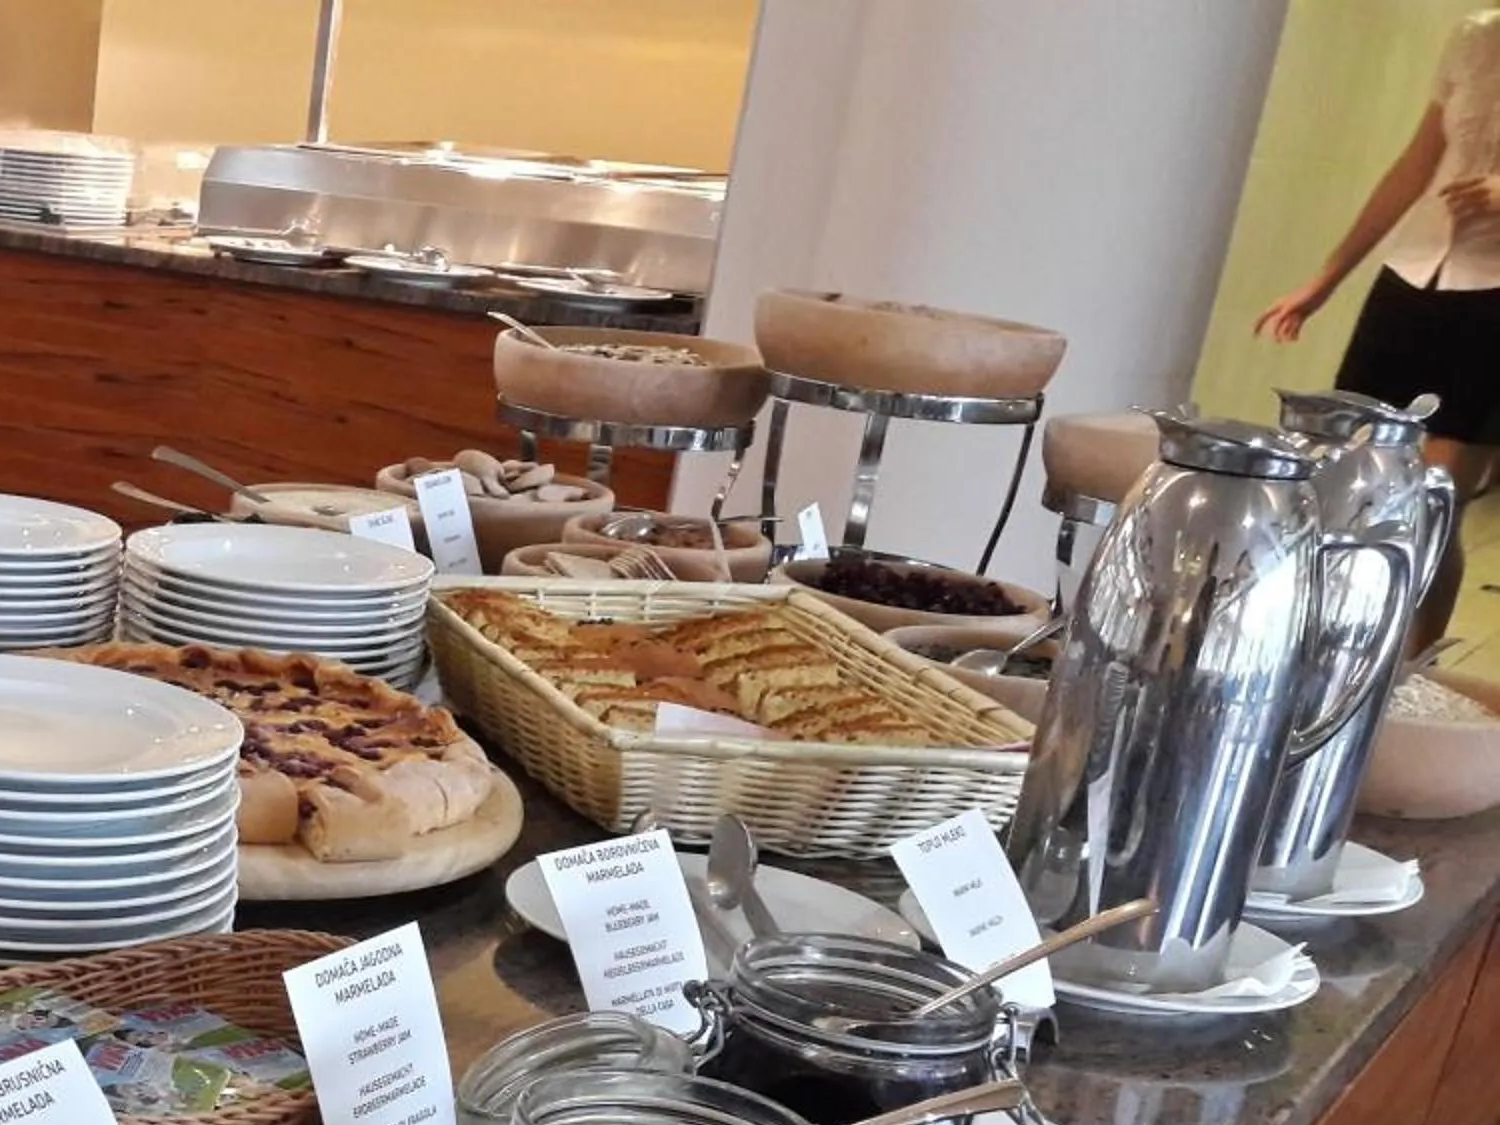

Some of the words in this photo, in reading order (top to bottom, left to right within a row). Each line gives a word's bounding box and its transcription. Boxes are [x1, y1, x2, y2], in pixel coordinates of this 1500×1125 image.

[586, 863, 645, 883] MARMELADA
[314, 958, 359, 989] DOMAČA
[359, 943, 404, 972] JAGODNA
[335, 969, 397, 1004] MARMELADA
[397, 1028, 412, 1045] JAM
